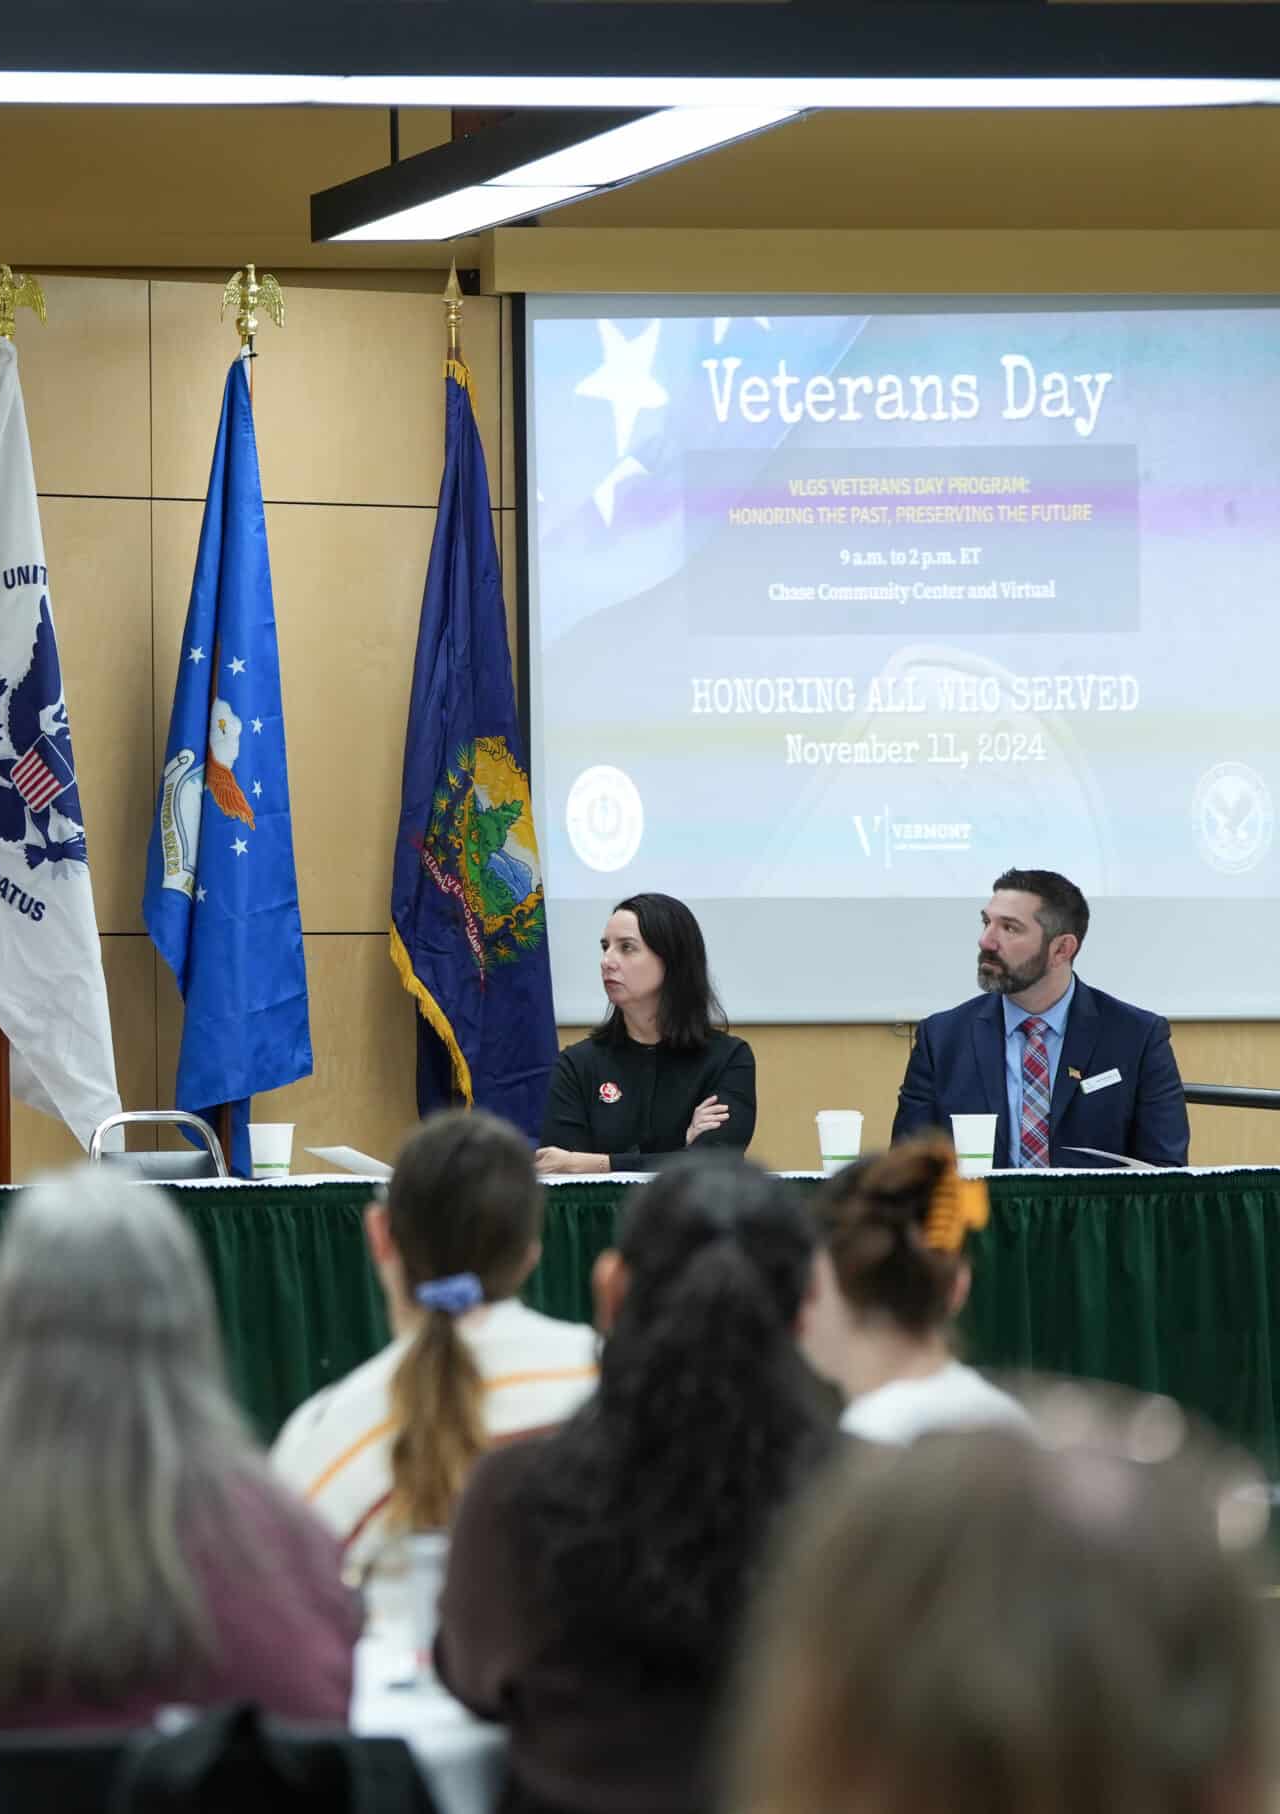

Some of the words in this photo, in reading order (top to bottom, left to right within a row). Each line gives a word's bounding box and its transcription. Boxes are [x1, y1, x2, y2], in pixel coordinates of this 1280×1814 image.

[701, 356, 980, 423] Veterans
[999, 353, 1114, 436] Day
[788, 479, 828, 496] VLGS
[831, 478, 911, 496] VETERANS
[914, 477, 944, 495] DAY
[728, 506, 815, 525] HONORING
[817, 506, 847, 524] THE
[850, 506, 892, 527] PAST,
[895, 505, 994, 524] PRESERVING
[997, 504, 1028, 522] THE
[1031, 503, 1093, 521] FUTURE
[839, 549, 850, 566] 9
[852, 550, 888, 566] a.m.
[890, 548, 907, 566] to
[908, 548, 919, 565] 2
[919, 549, 957, 570] p.m.
[959, 547, 983, 565] ET
[768, 583, 817, 600] Chase
[818, 580, 911, 604] Community
[911, 581, 968, 600] Center
[967, 580, 998, 599] and
[999, 579, 1057, 598] Virtual
[691, 676, 857, 714] HONORING
[863, 676, 928, 713] ALL
[936, 675, 1001, 713] WHO
[1011, 673, 1140, 712] SERVED
[785, 733, 921, 765] November
[927, 732, 969, 769] 11,
[977, 732, 1049, 763] 2024
